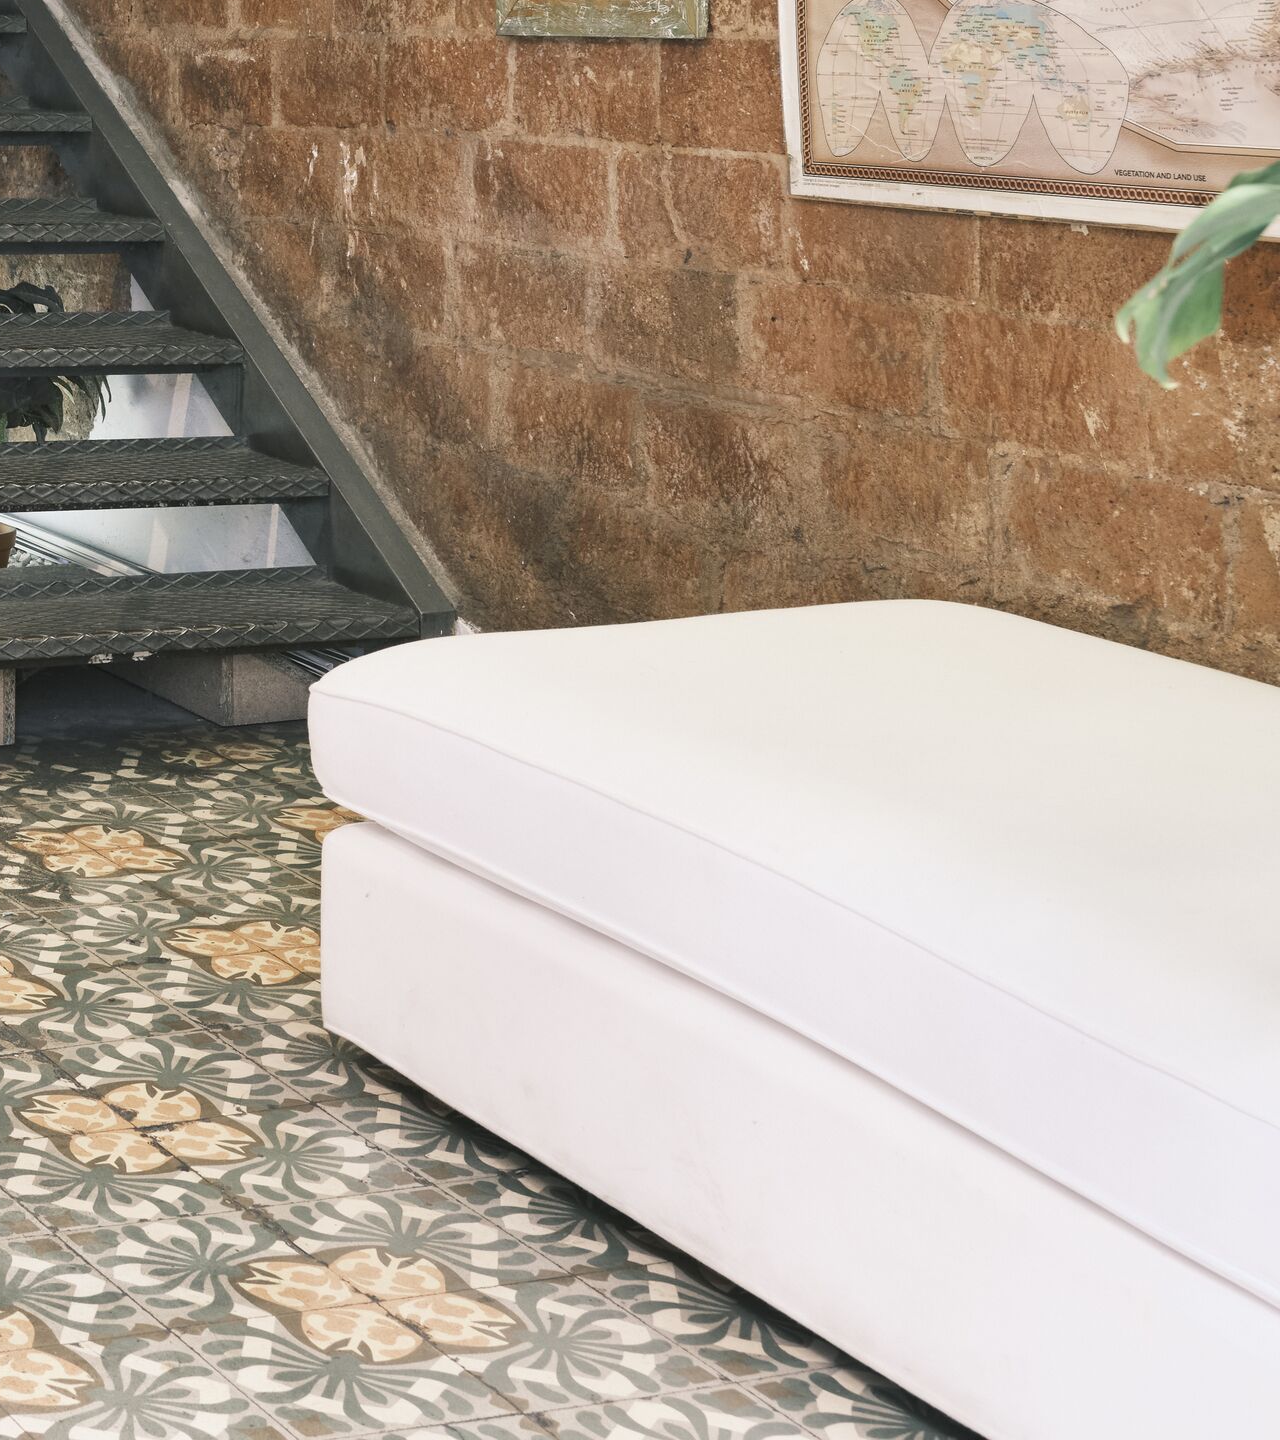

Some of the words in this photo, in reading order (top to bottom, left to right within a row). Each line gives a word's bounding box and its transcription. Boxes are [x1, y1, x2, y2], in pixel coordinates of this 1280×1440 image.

[1114, 168, 1155, 179] VEGETATION
[1156, 171, 1172, 179] AND
[1173, 172, 1192, 181] LAND
[1192, 173, 1207, 182] USE
